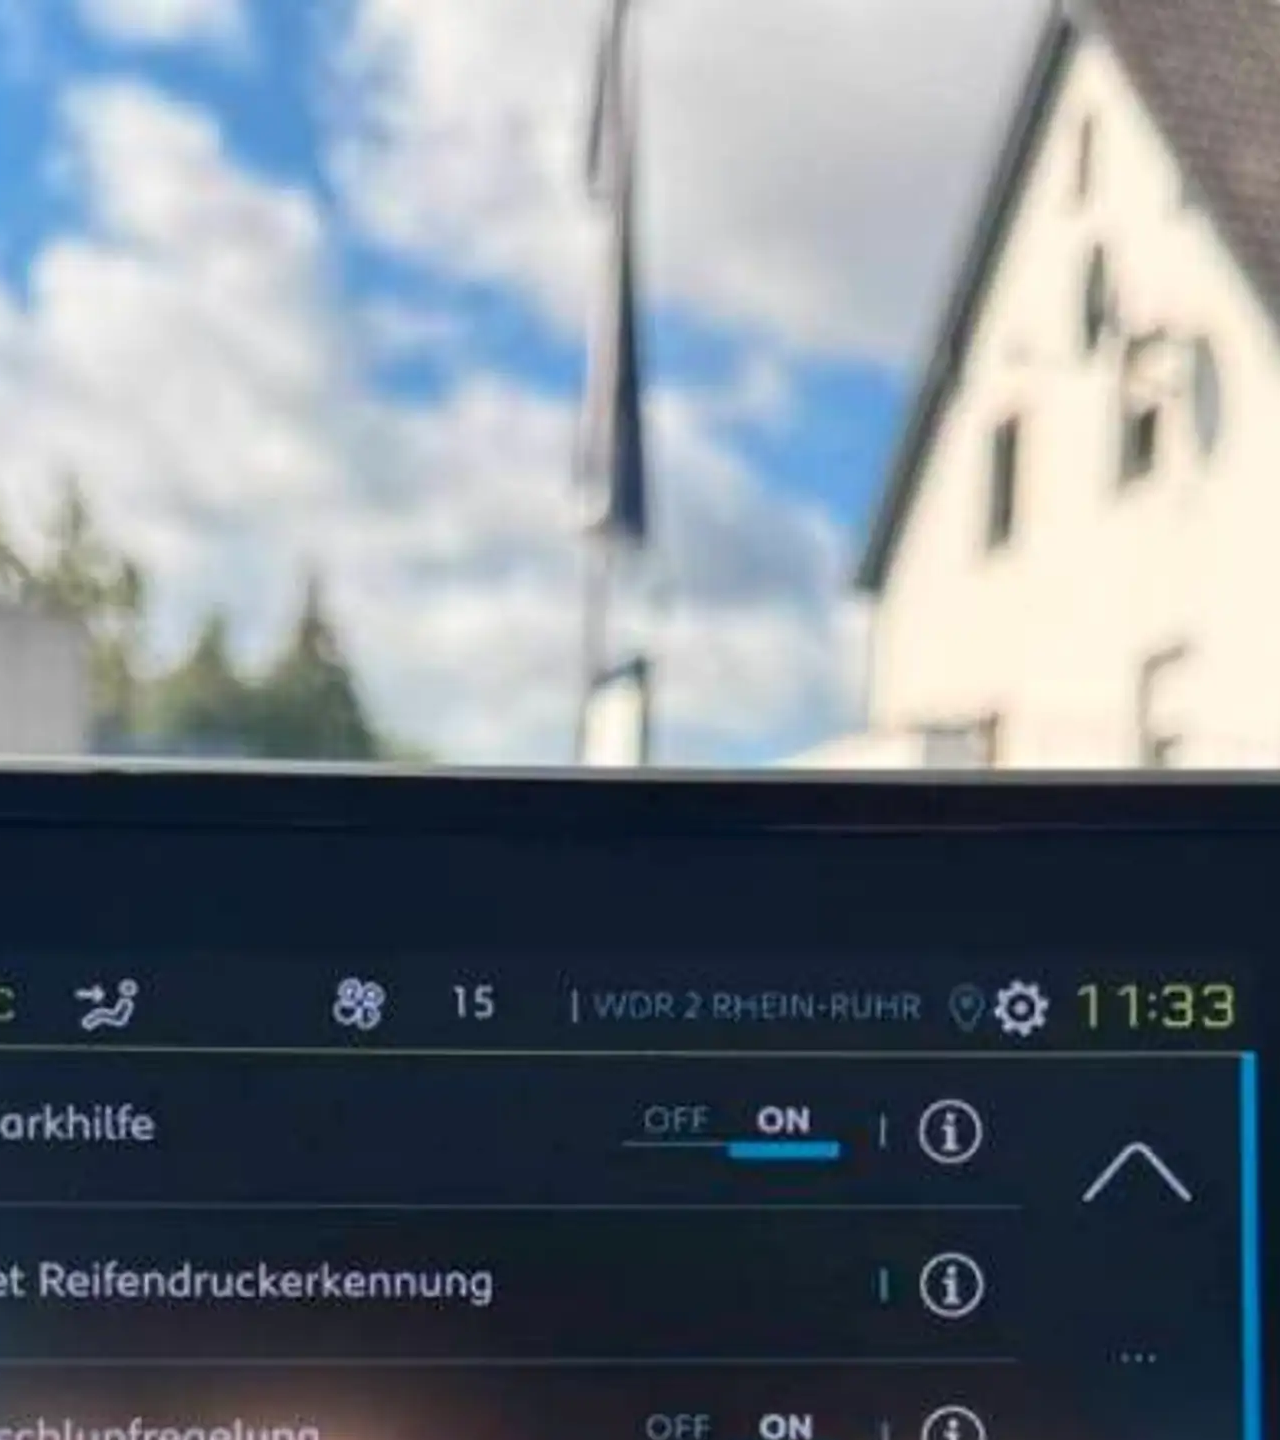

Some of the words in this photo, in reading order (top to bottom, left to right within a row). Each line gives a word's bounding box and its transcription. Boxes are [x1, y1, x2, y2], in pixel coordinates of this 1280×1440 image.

[453, 984, 495, 1020] 15
[593, 990, 675, 1020] WDR
[683, 990, 703, 1020] 2
[712, 991, 922, 1021] RHEIN-RUHR
[1076, 983, 1235, 1029] 11:33
[643, 1104, 709, 1133] OFF
[756, 1105, 811, 1134] ON
[38, 1259, 494, 1307] Reifendruckerkennung
